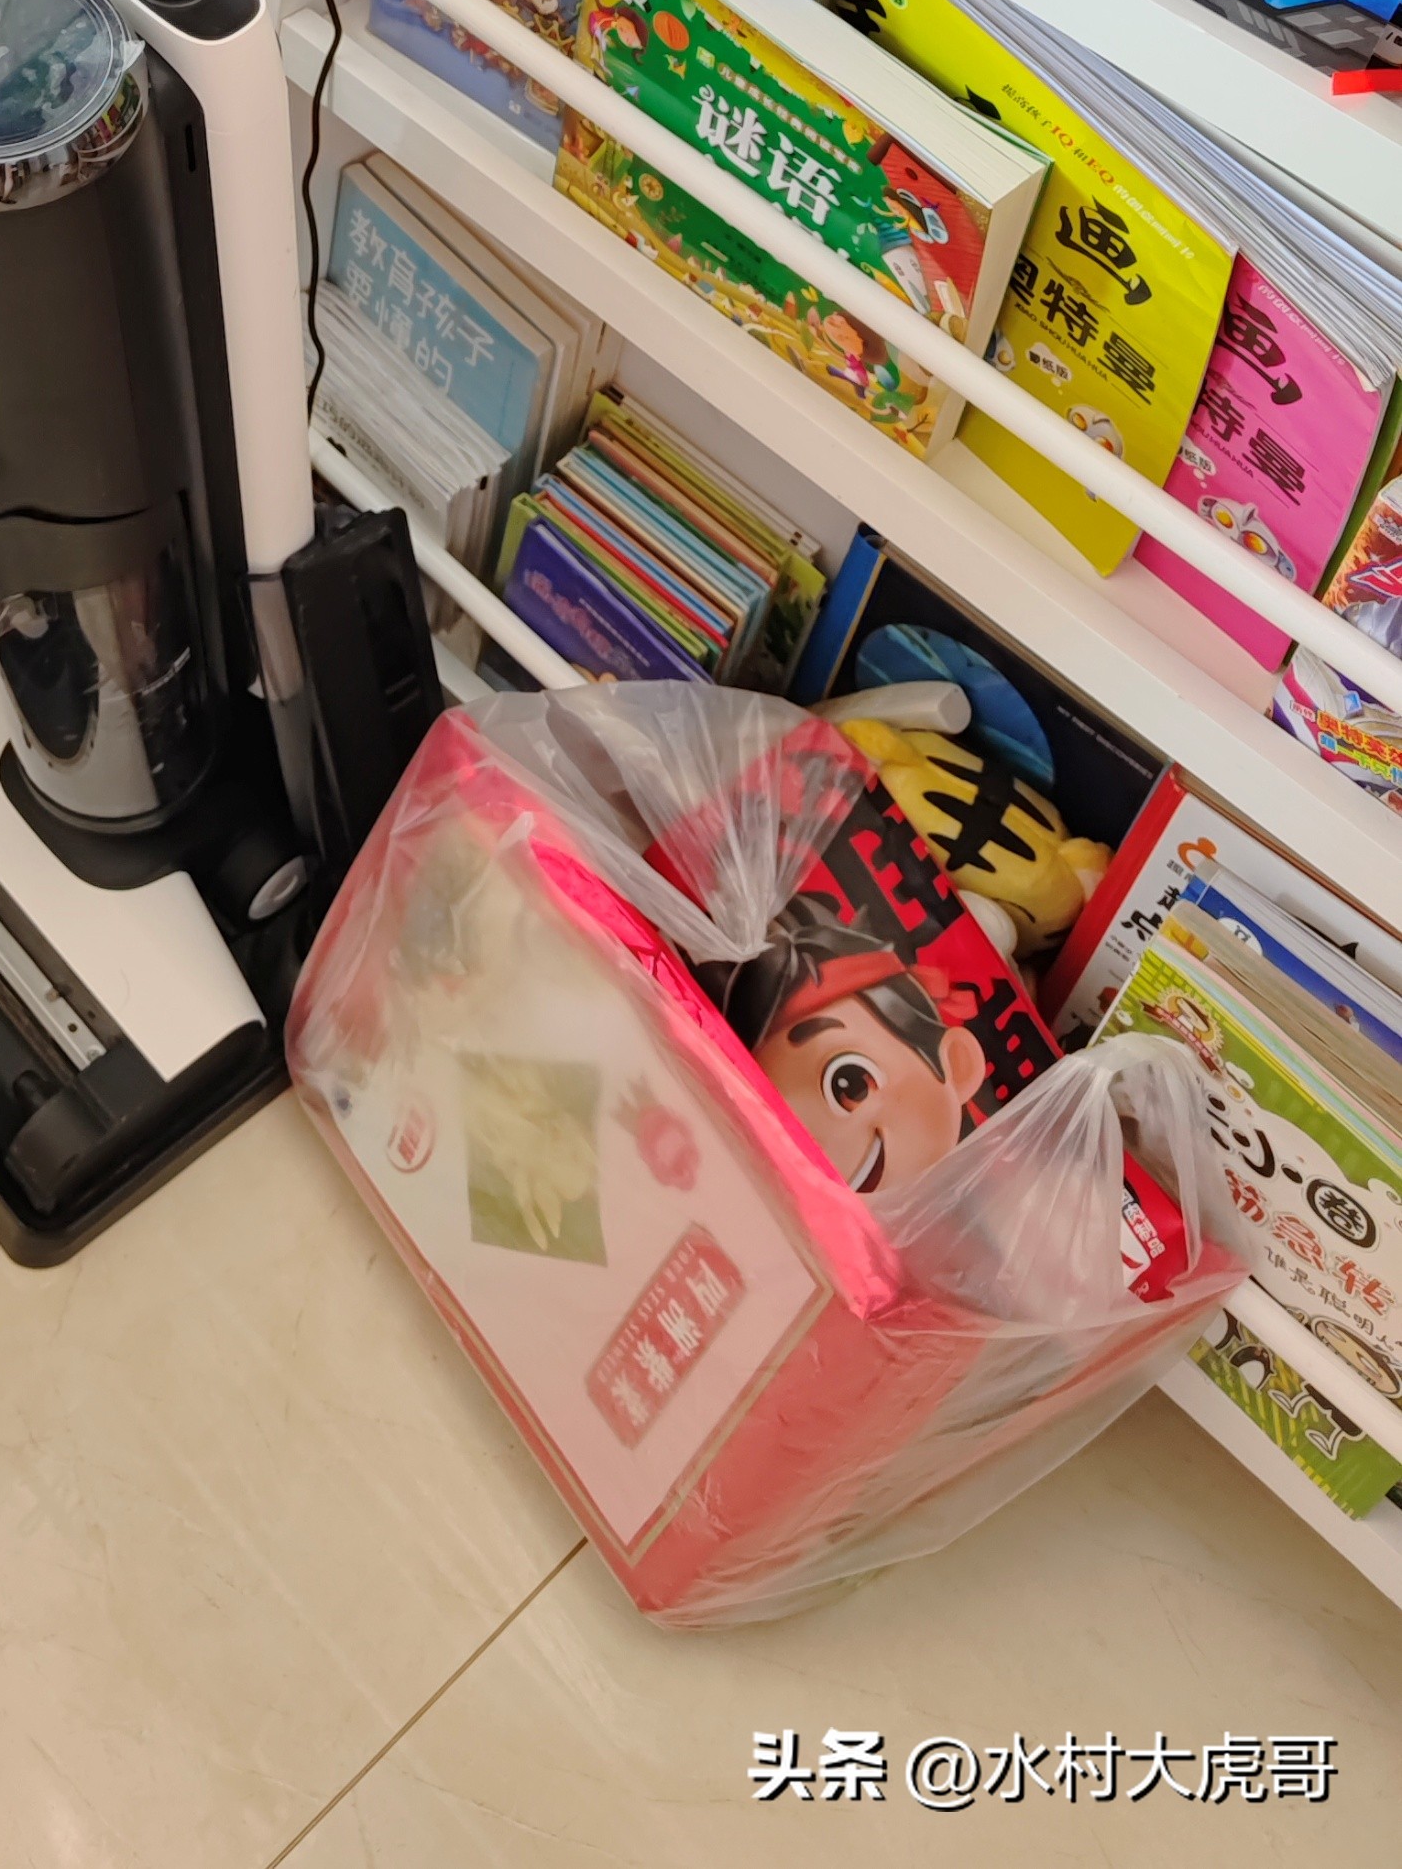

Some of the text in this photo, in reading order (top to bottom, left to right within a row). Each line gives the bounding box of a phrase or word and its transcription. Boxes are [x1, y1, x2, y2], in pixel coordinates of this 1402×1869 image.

[692, 83, 842, 227] 谜语
[349, 208, 496, 368] 教育孩子
[609, 1257, 731, 1428] 四洲紫菜
